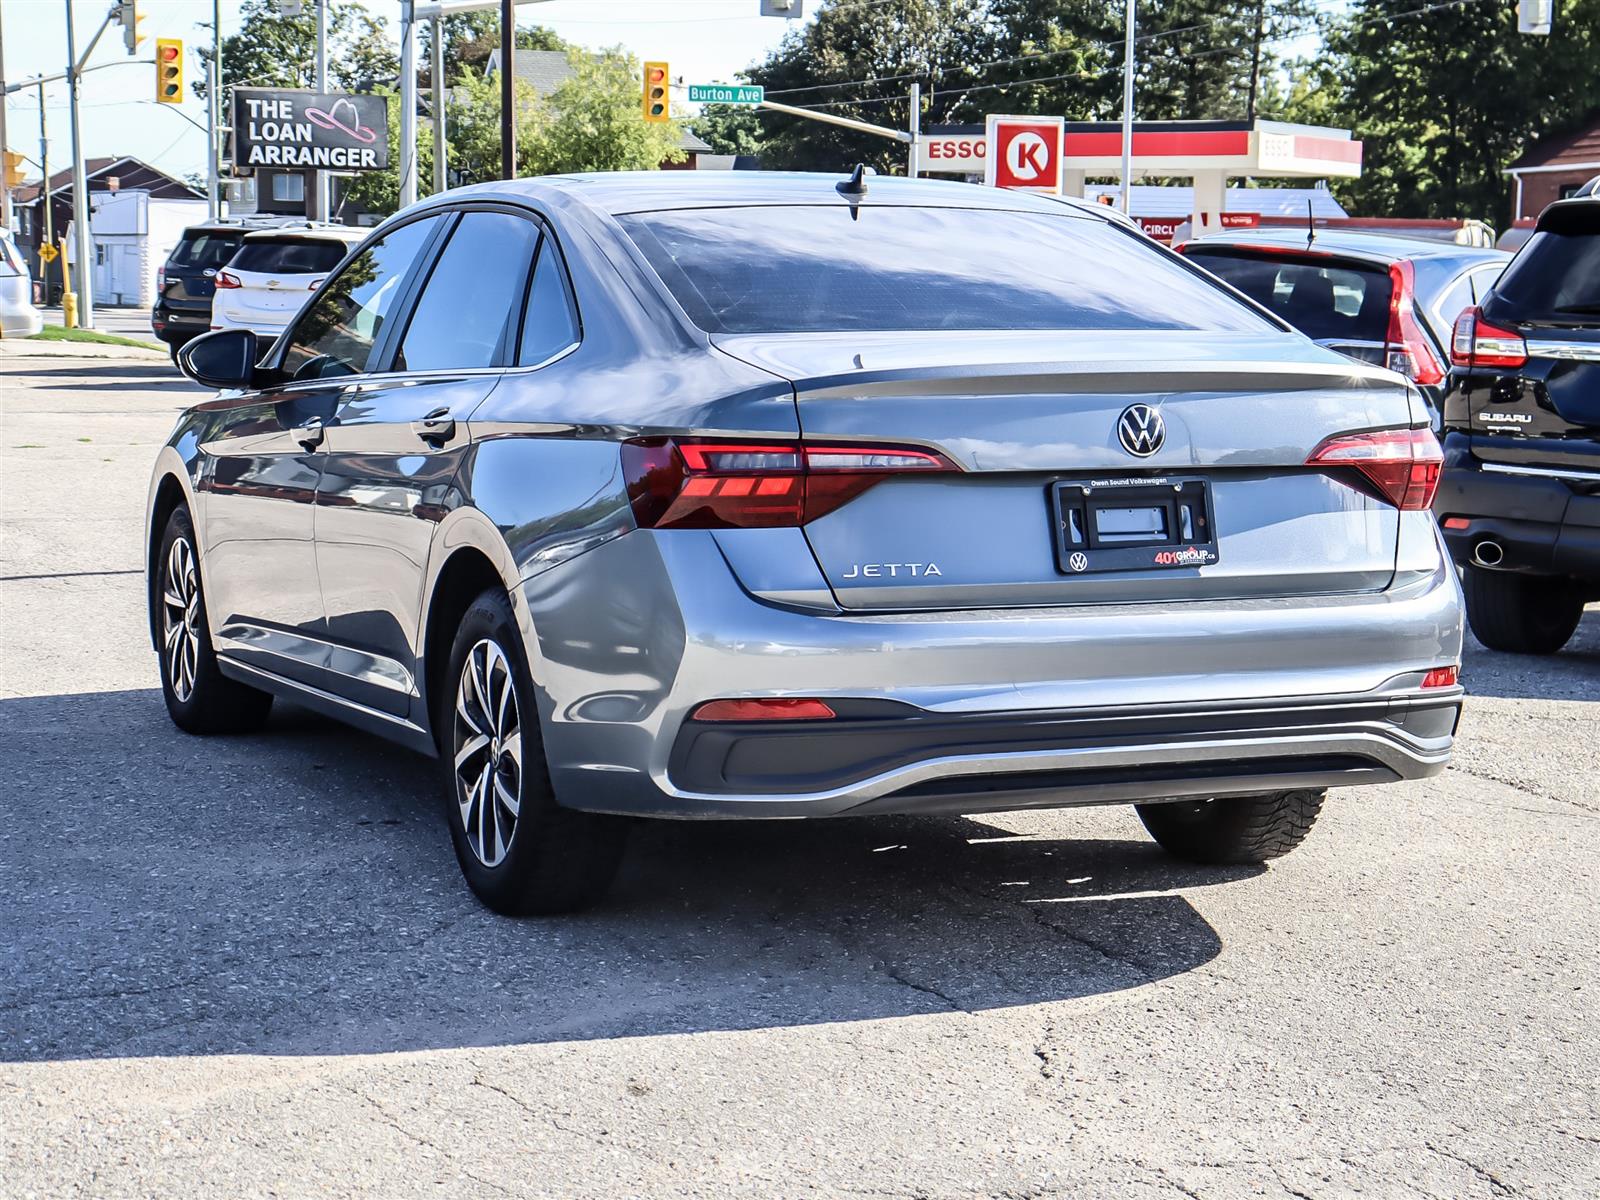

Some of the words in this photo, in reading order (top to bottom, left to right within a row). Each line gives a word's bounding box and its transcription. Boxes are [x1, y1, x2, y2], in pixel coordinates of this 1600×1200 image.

[691, 87, 732, 100] Burton
[737, 88, 759, 101] Ave
[246, 99, 293, 119] THE
[249, 121, 312, 142] LOAN
[248, 145, 377, 167] ARRANGER
[929, 141, 986, 158] ESSO
[1018, 143, 1043, 176] K
[1143, 224, 1177, 235] CIRCL
[1479, 412, 1532, 423] SUBARU
[1091, 479, 1109, 487] Owen
[1110, 478, 1130, 486] Sound
[1130, 477, 1168, 486] Volkswagen
[843, 563, 942, 578] JETTA
